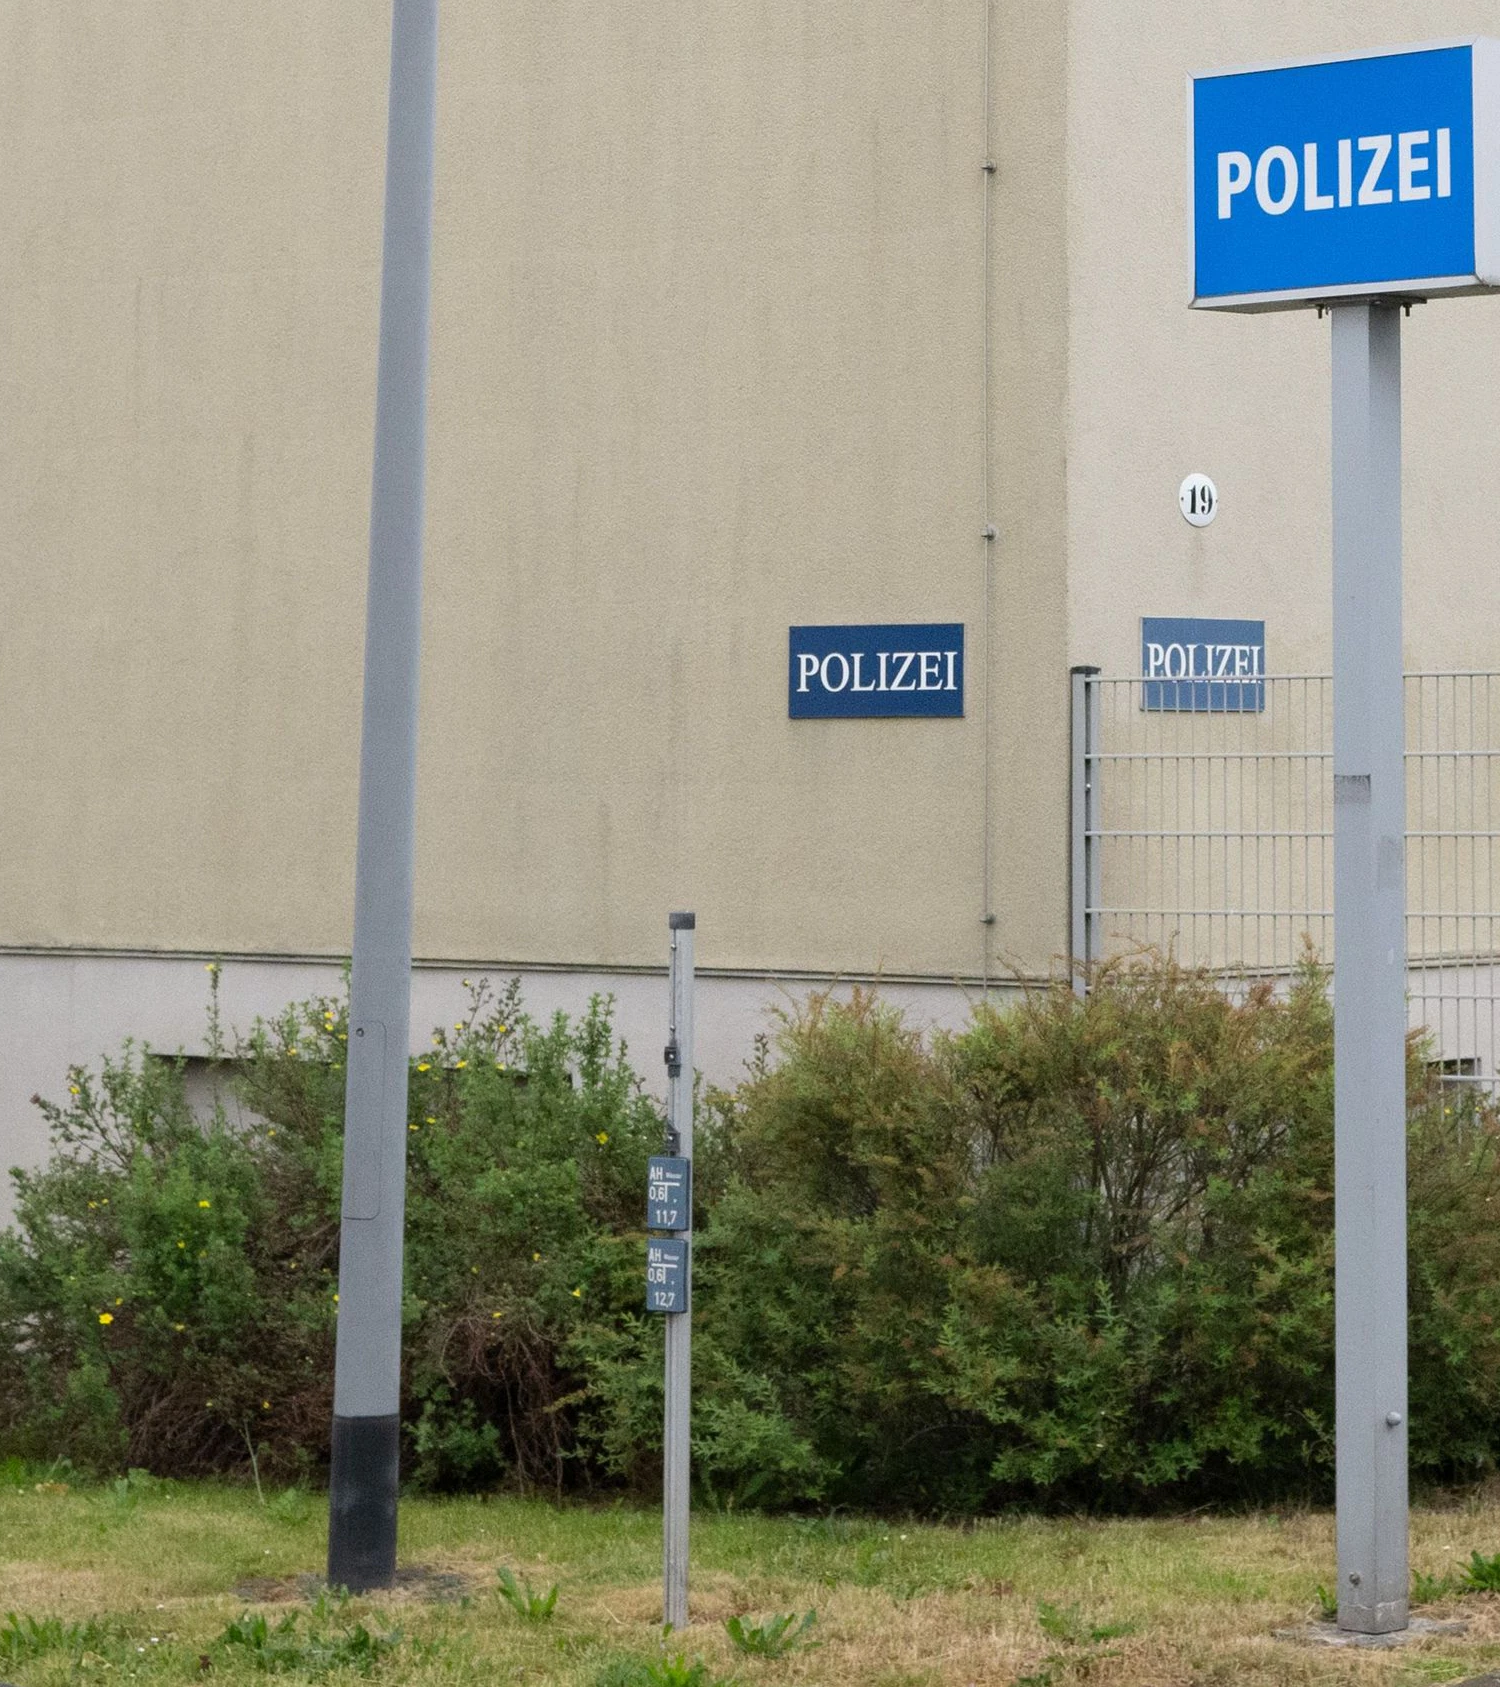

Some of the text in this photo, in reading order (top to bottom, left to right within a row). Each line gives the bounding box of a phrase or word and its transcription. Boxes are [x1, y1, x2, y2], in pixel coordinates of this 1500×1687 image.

[1217, 127, 1451, 220] POLIZEI
[1188, 485, 1213, 515] 19
[796, 651, 959, 693] POLIZEI
[1146, 643, 1263, 684] POLIZEI
[650, 1166, 663, 1180] AH
[656, 1210, 678, 1227] 11,7
[649, 1247, 661, 1262] AH
[655, 1292, 675, 1308] 12,7
